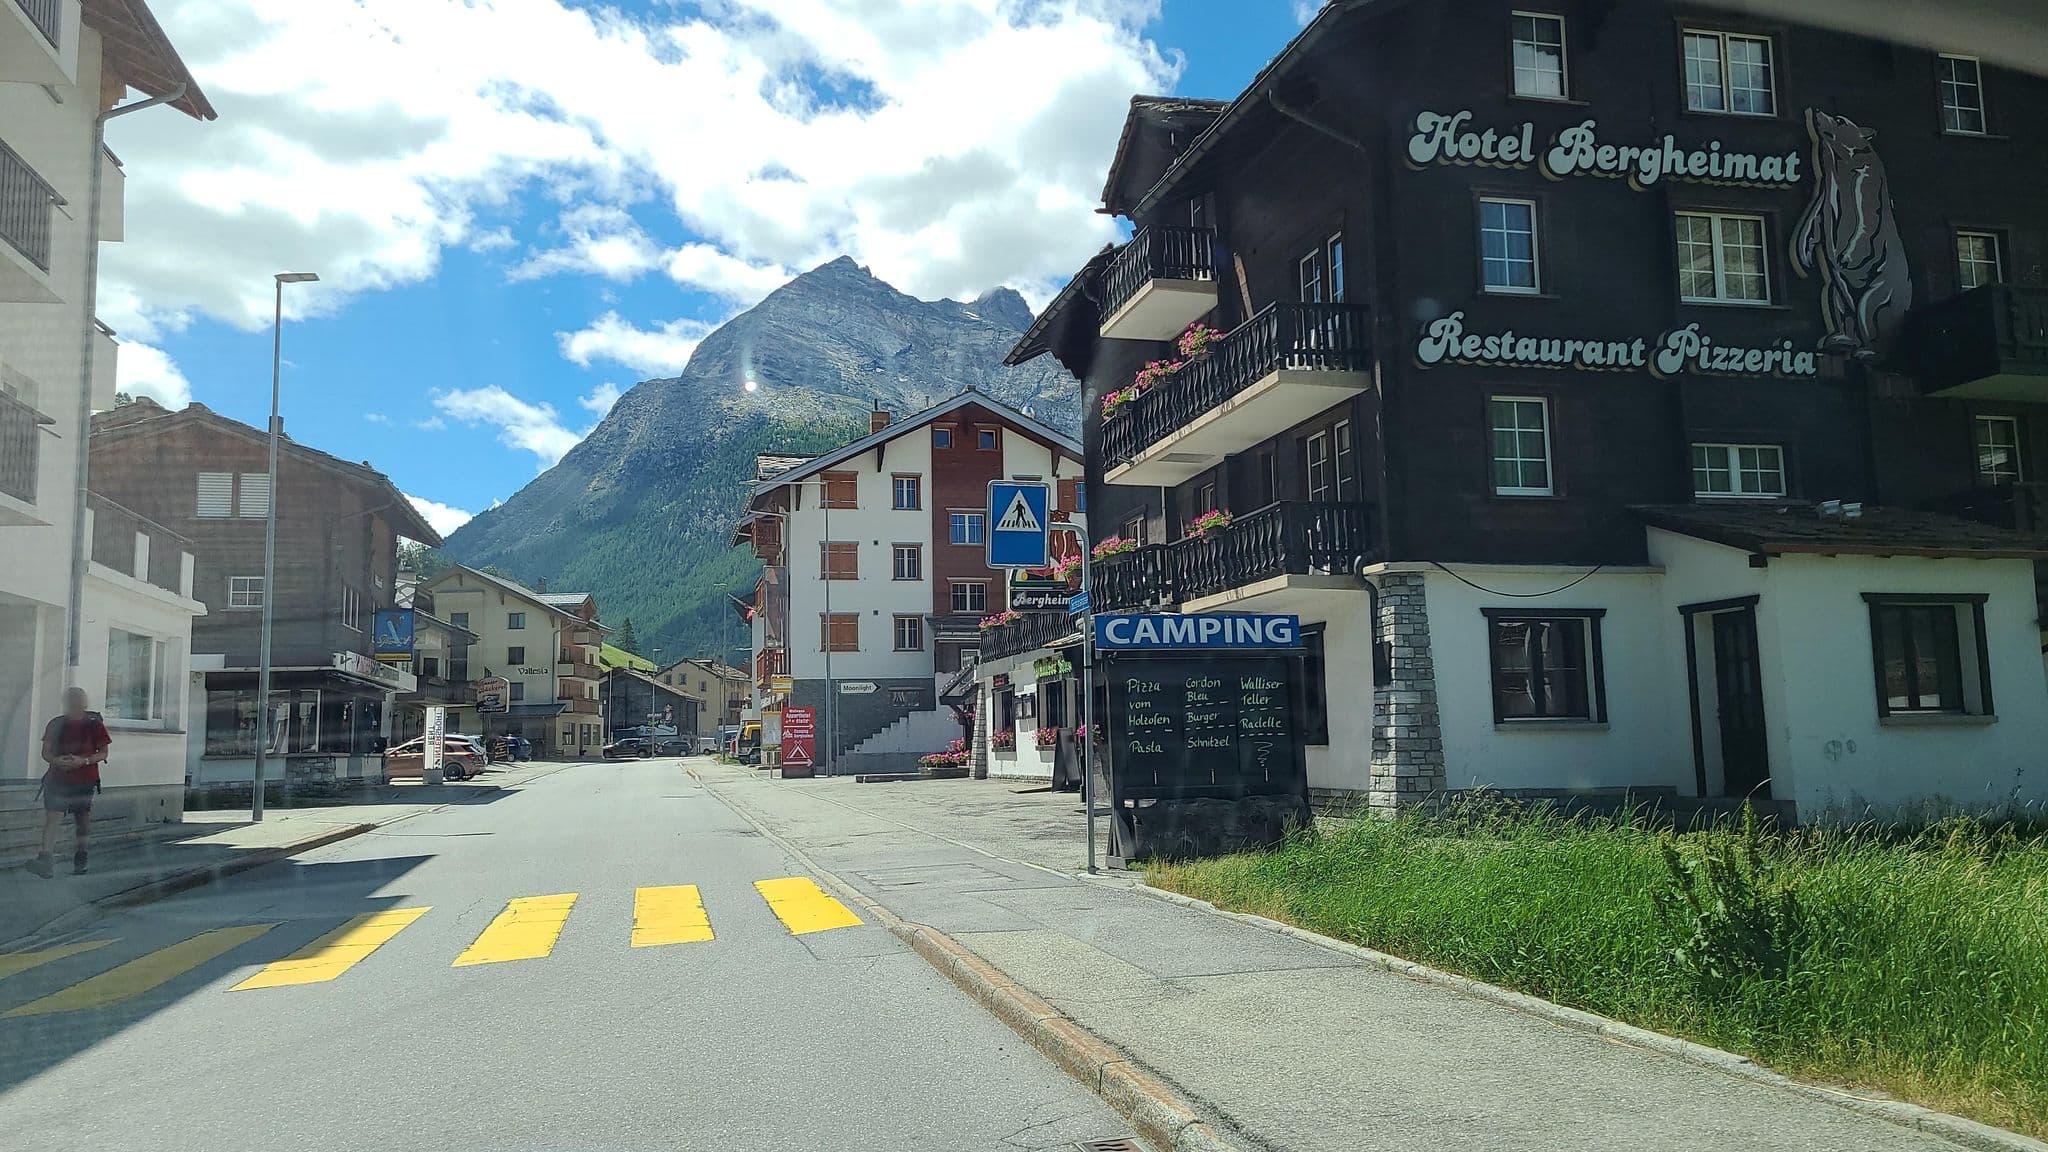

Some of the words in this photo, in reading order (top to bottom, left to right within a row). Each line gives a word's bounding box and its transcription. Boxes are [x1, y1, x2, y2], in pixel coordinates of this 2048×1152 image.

[1408, 110, 1535, 163] Hotel
[1548, 119, 1801, 185] Bergheimat
[1418, 311, 1646, 366] Restaurant
[1657, 322, 1817, 375] Pizzeria
[1105, 618, 1292, 644] CAMPING
[843, 684, 872, 692] Moonlight
[1127, 678, 1162, 693] Pizza
[1185, 676, 1221, 689] Cordon
[1240, 676, 1284, 690] Walliser
[1186, 690, 1209, 702] Bleu
[1241, 692, 1272, 705] Teller
[1129, 701, 1151, 710] vom
[1128, 712, 1170, 727] Holzofen
[1185, 711, 1220, 724] Burger
[1128, 740, 1164, 754] Pasta
[1187, 735, 1230, 749] Schnitzel
